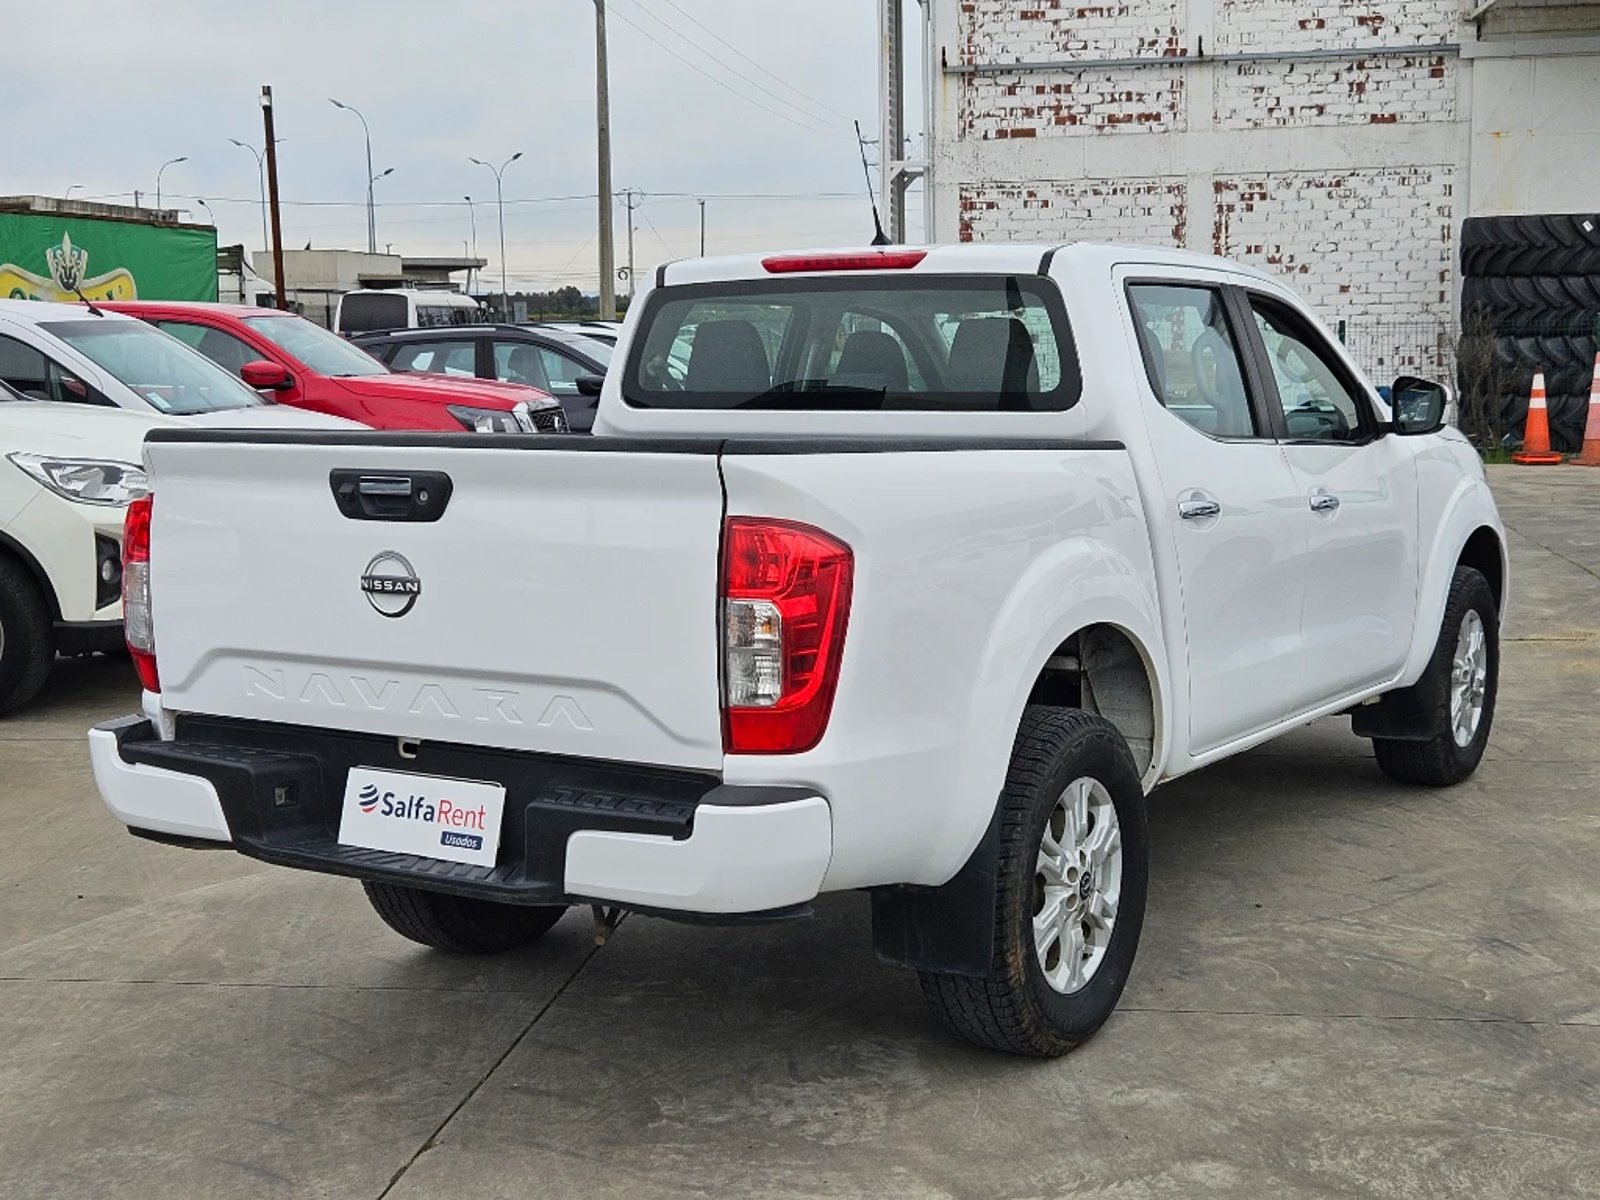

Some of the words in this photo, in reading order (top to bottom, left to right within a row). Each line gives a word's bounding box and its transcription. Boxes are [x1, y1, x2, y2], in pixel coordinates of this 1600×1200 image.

[361, 579, 418, 592] NISSAN
[244, 665, 595, 731] NAVARA
[381, 792, 487, 830] SalfaRent
[444, 832, 478, 848] Usados
